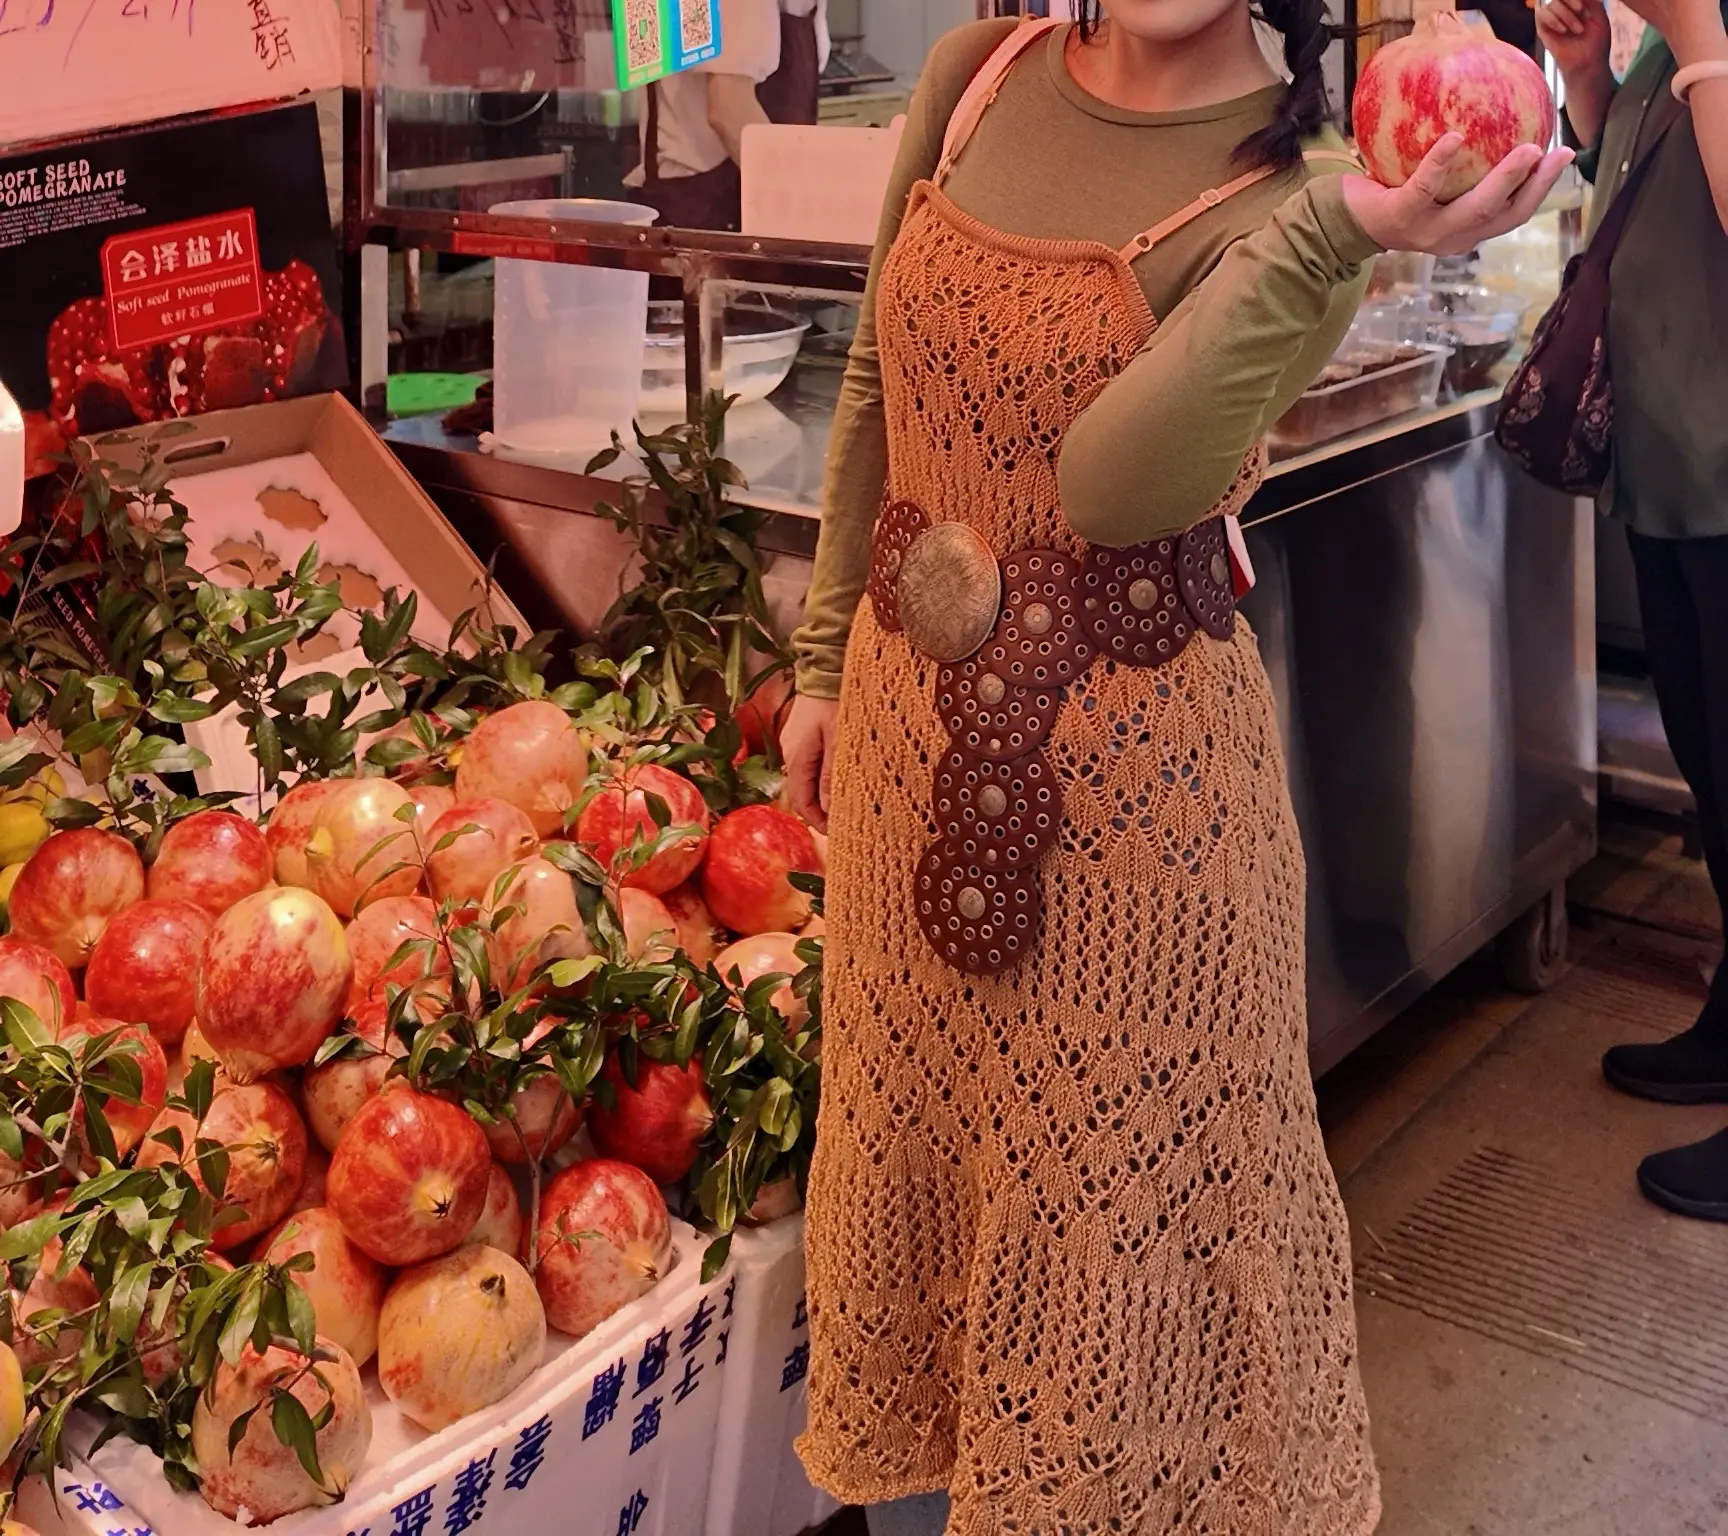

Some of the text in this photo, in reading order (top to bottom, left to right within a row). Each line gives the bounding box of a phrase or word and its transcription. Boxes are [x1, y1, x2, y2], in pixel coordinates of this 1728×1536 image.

[45, 159, 90, 183] SEED
[120, 229, 244, 283] 会泽盐水
[117, 273, 251, 316] Soft seed Pomegranate
